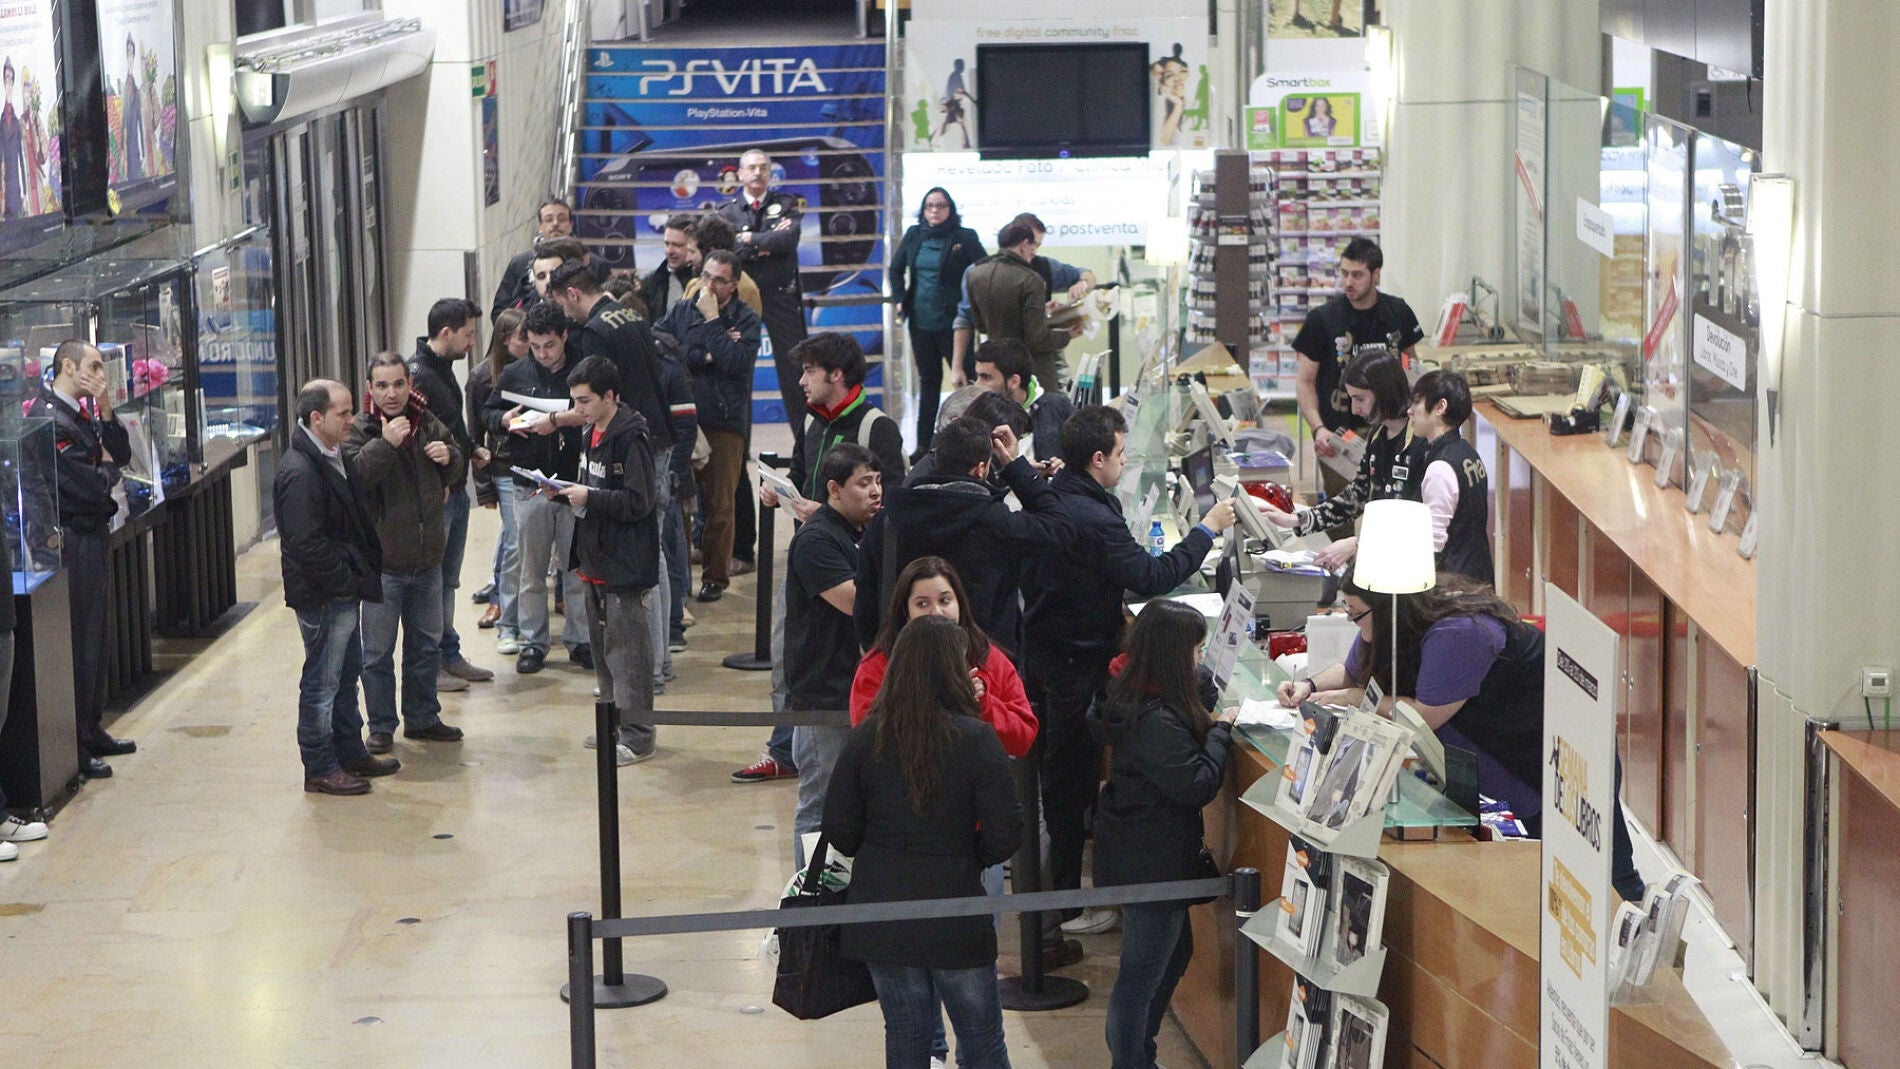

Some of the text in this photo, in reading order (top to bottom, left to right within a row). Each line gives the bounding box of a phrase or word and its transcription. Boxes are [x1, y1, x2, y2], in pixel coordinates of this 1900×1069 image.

[1003, 26, 1042, 39] digital
[1044, 26, 1110, 39] community
[1266, 77, 1332, 88] Smartbox
[1060, 223, 1140, 238] postventa
